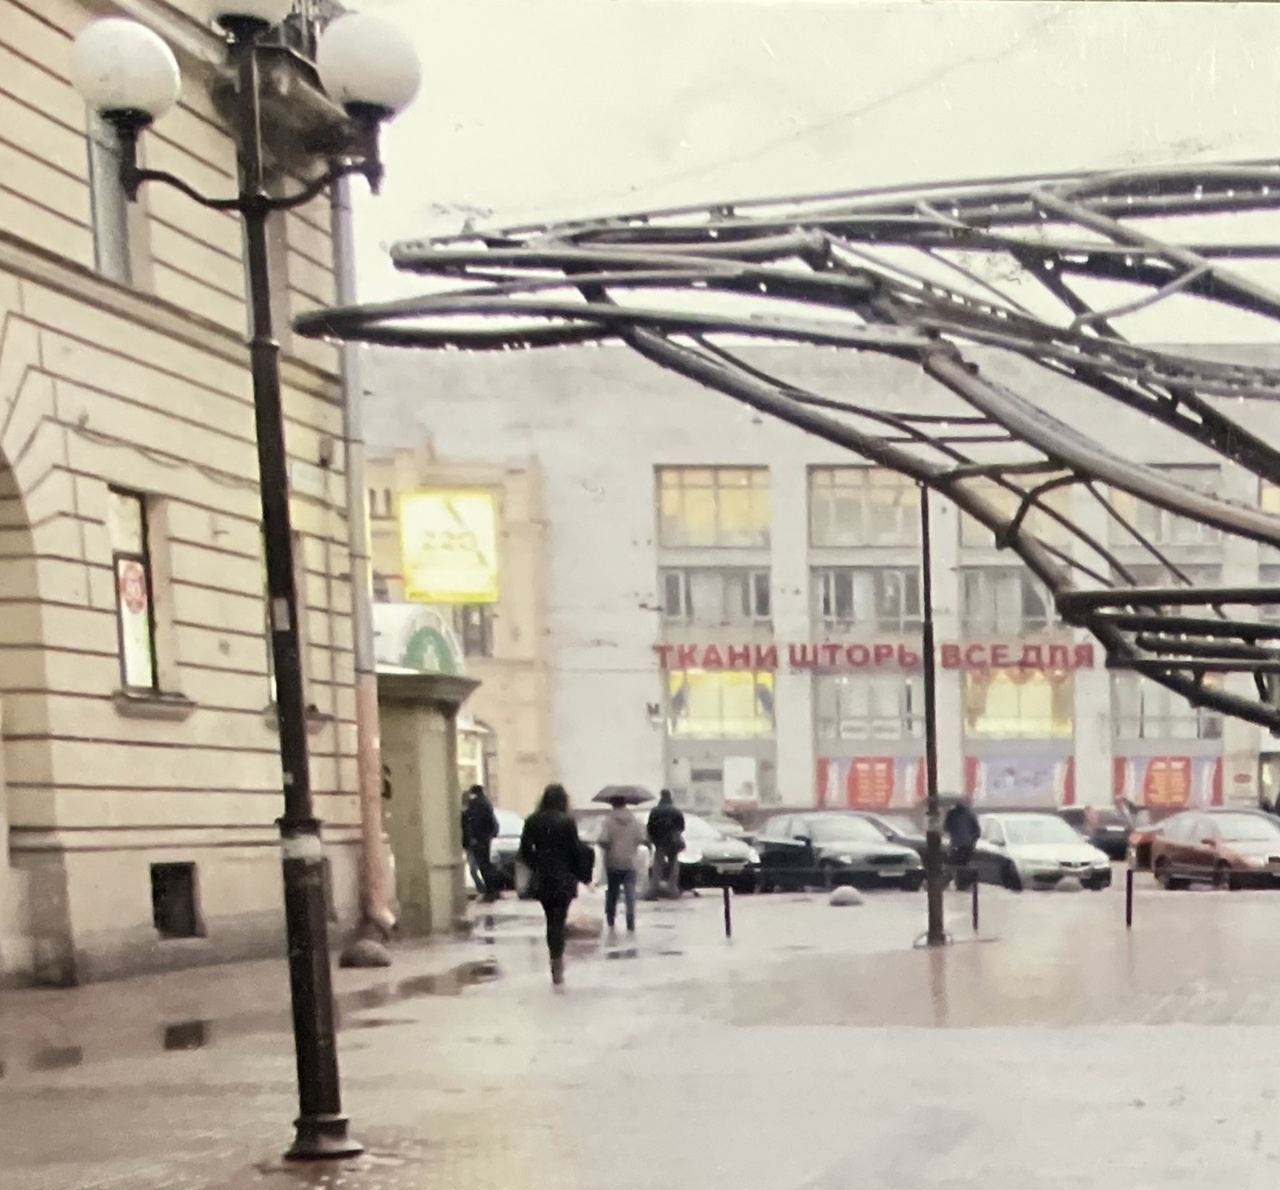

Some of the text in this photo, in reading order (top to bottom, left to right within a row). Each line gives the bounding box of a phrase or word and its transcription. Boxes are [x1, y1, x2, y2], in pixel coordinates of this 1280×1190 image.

[652, 644, 779, 669] ТКАНИ
[941, 643, 1009, 669] ВСЕ
[1019, 643, 1094, 671] ДЛЯ
